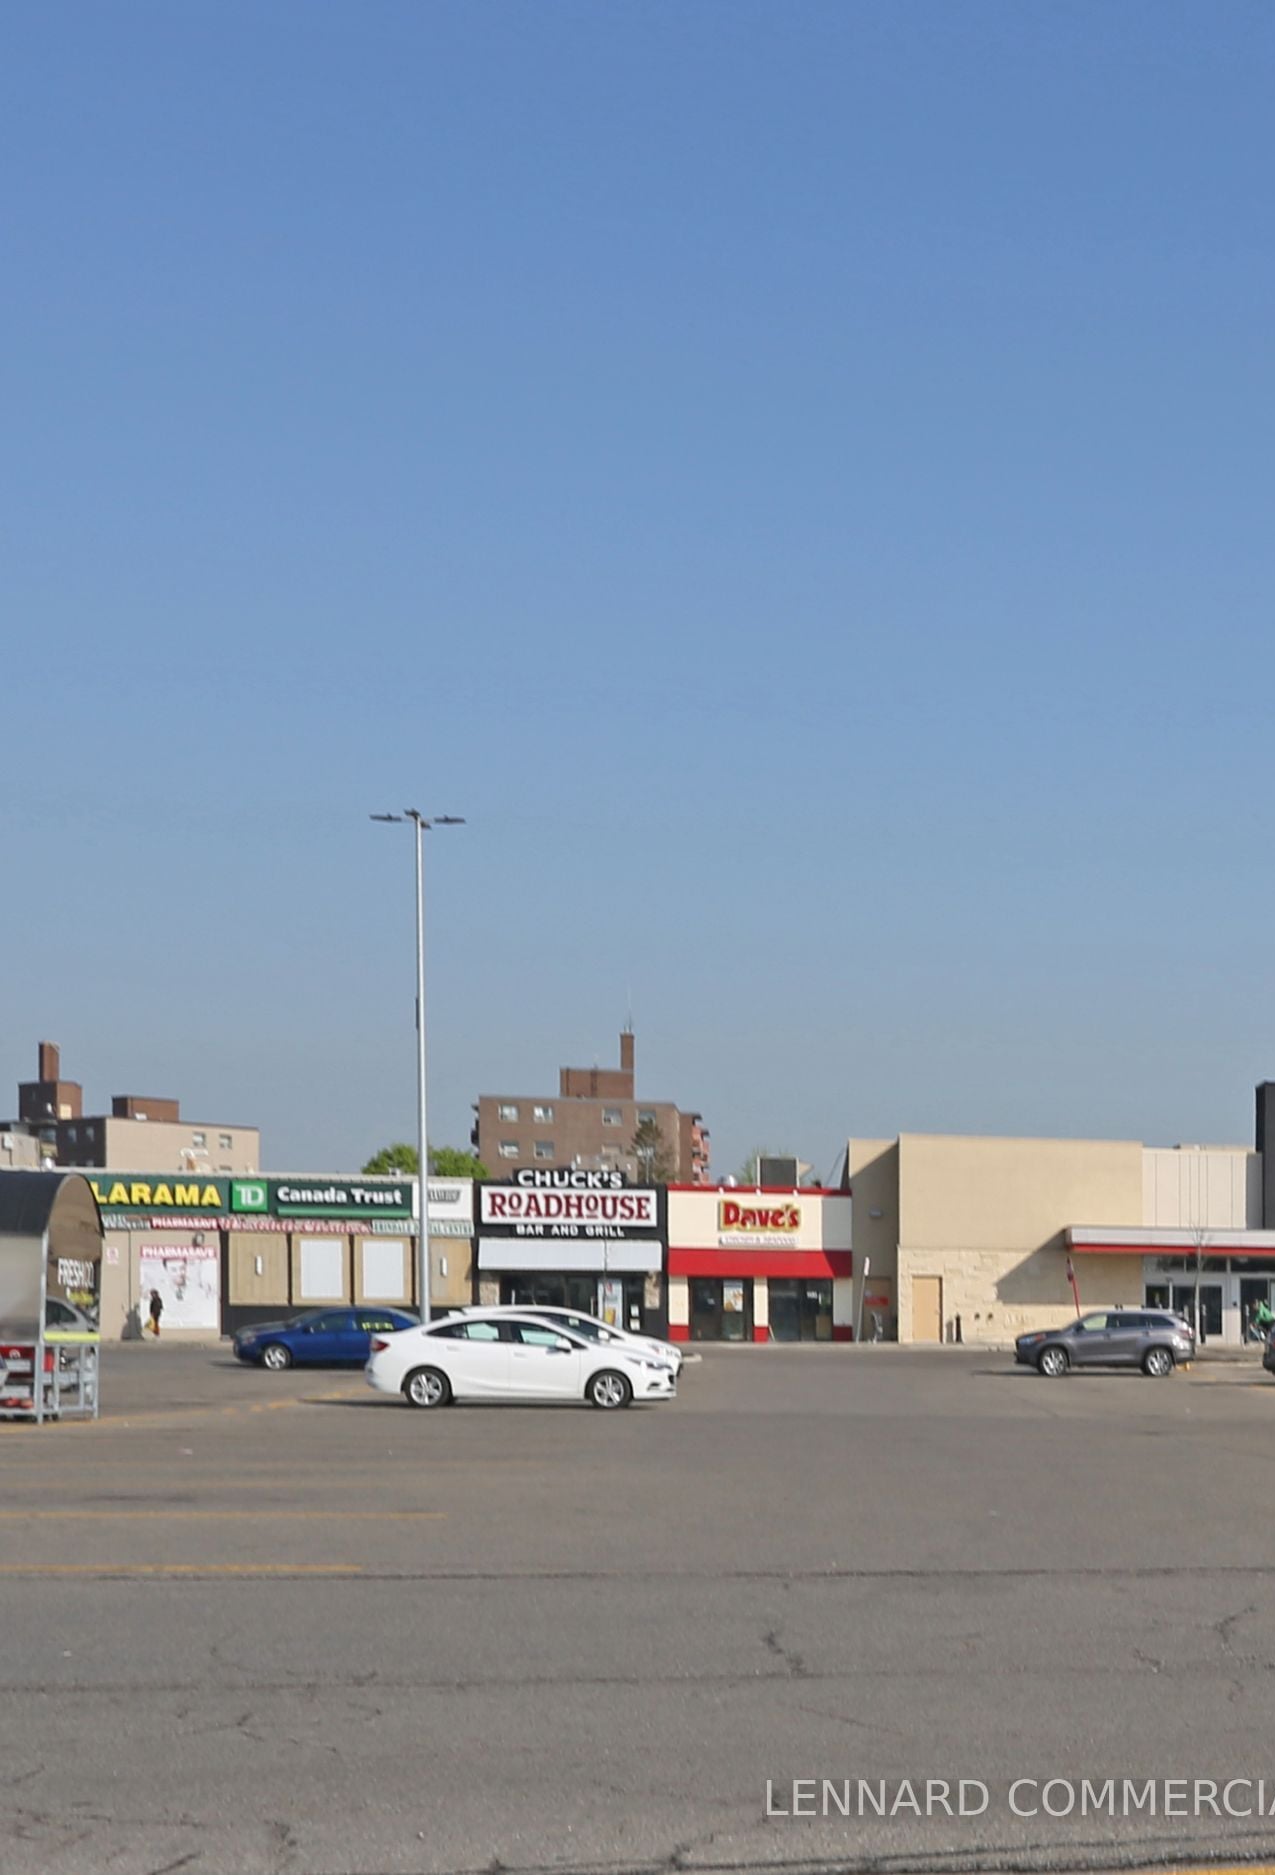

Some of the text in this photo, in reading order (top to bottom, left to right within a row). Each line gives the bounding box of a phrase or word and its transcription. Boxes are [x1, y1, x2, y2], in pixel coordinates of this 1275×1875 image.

[517, 1169, 623, 1189] CHUCK'S
[235, 1184, 265, 1206] TD
[277, 1186, 403, 1205] Canada Trust
[488, 1192, 651, 1220] ROADHOUSE
[721, 1199, 801, 1230] Dave's
[517, 1224, 625, 1238] BAR AND GRILL
